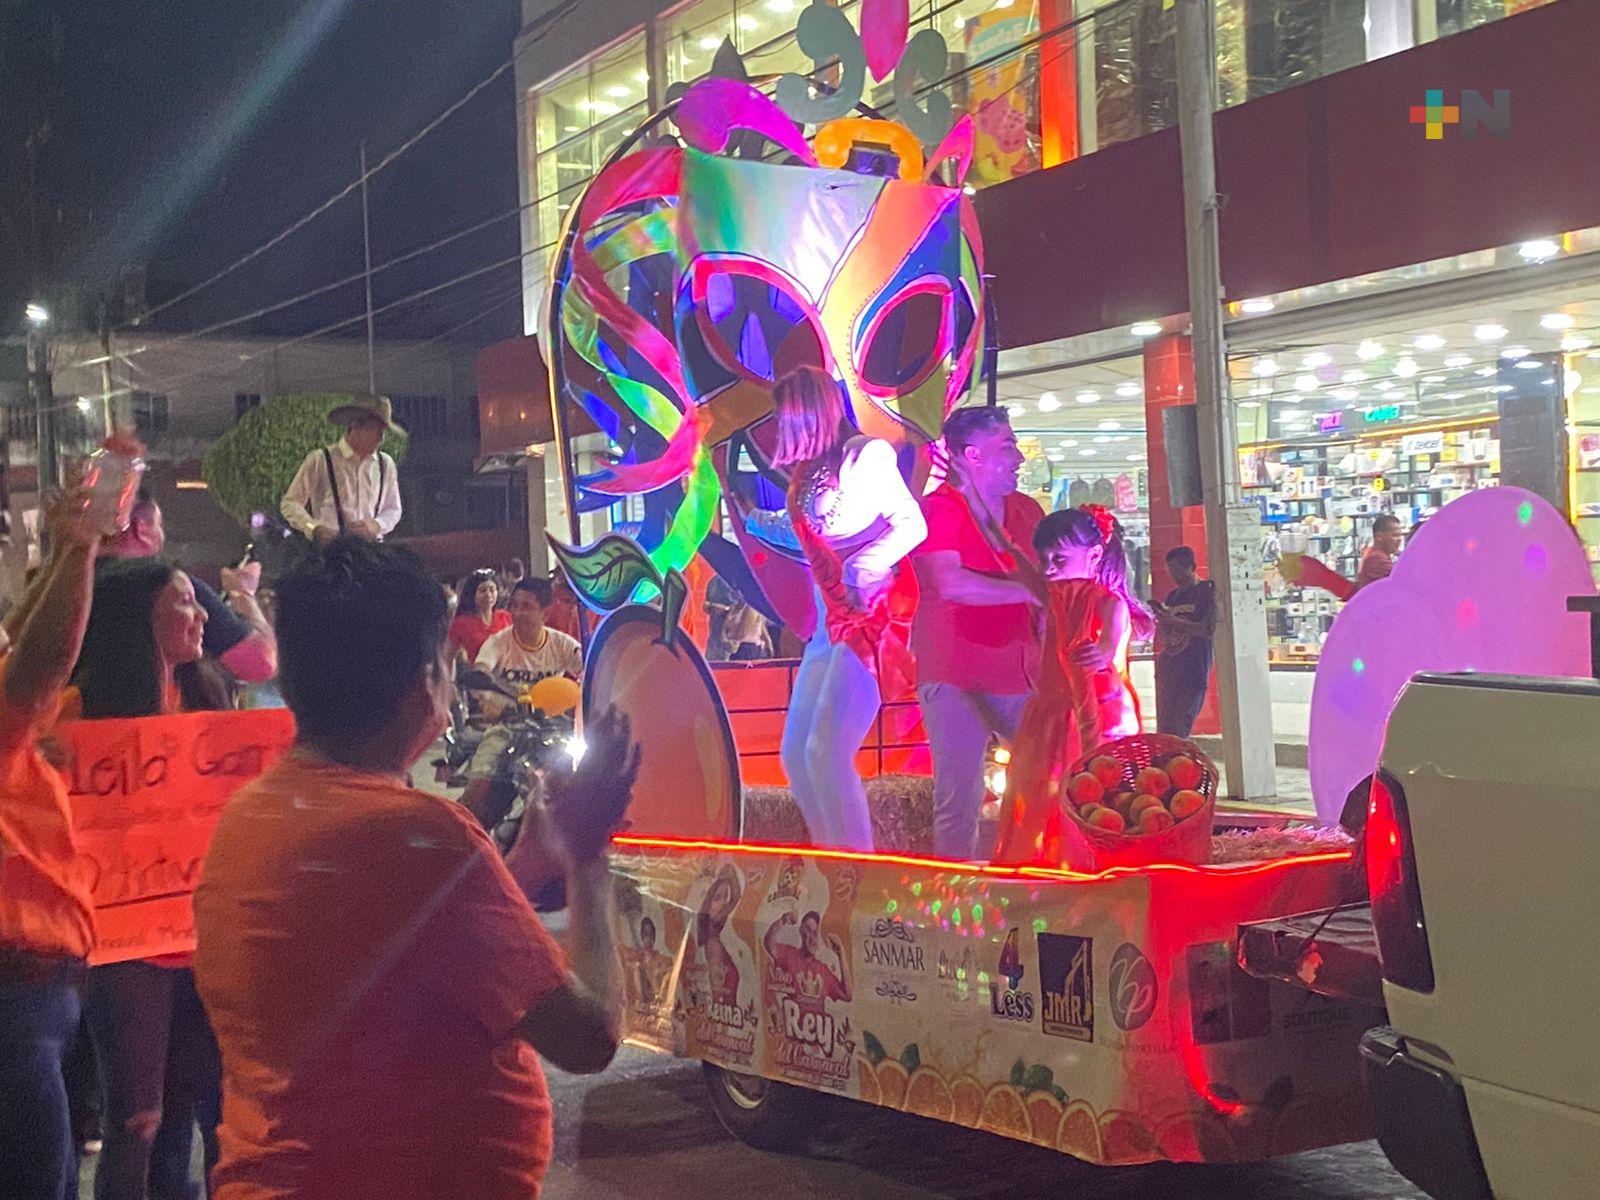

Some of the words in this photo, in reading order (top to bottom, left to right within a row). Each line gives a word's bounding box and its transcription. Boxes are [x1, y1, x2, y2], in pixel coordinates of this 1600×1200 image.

[863, 939, 925, 972] SANMAR
[989, 982, 1034, 1023] Less
[783, 998, 833, 1056] Rey
